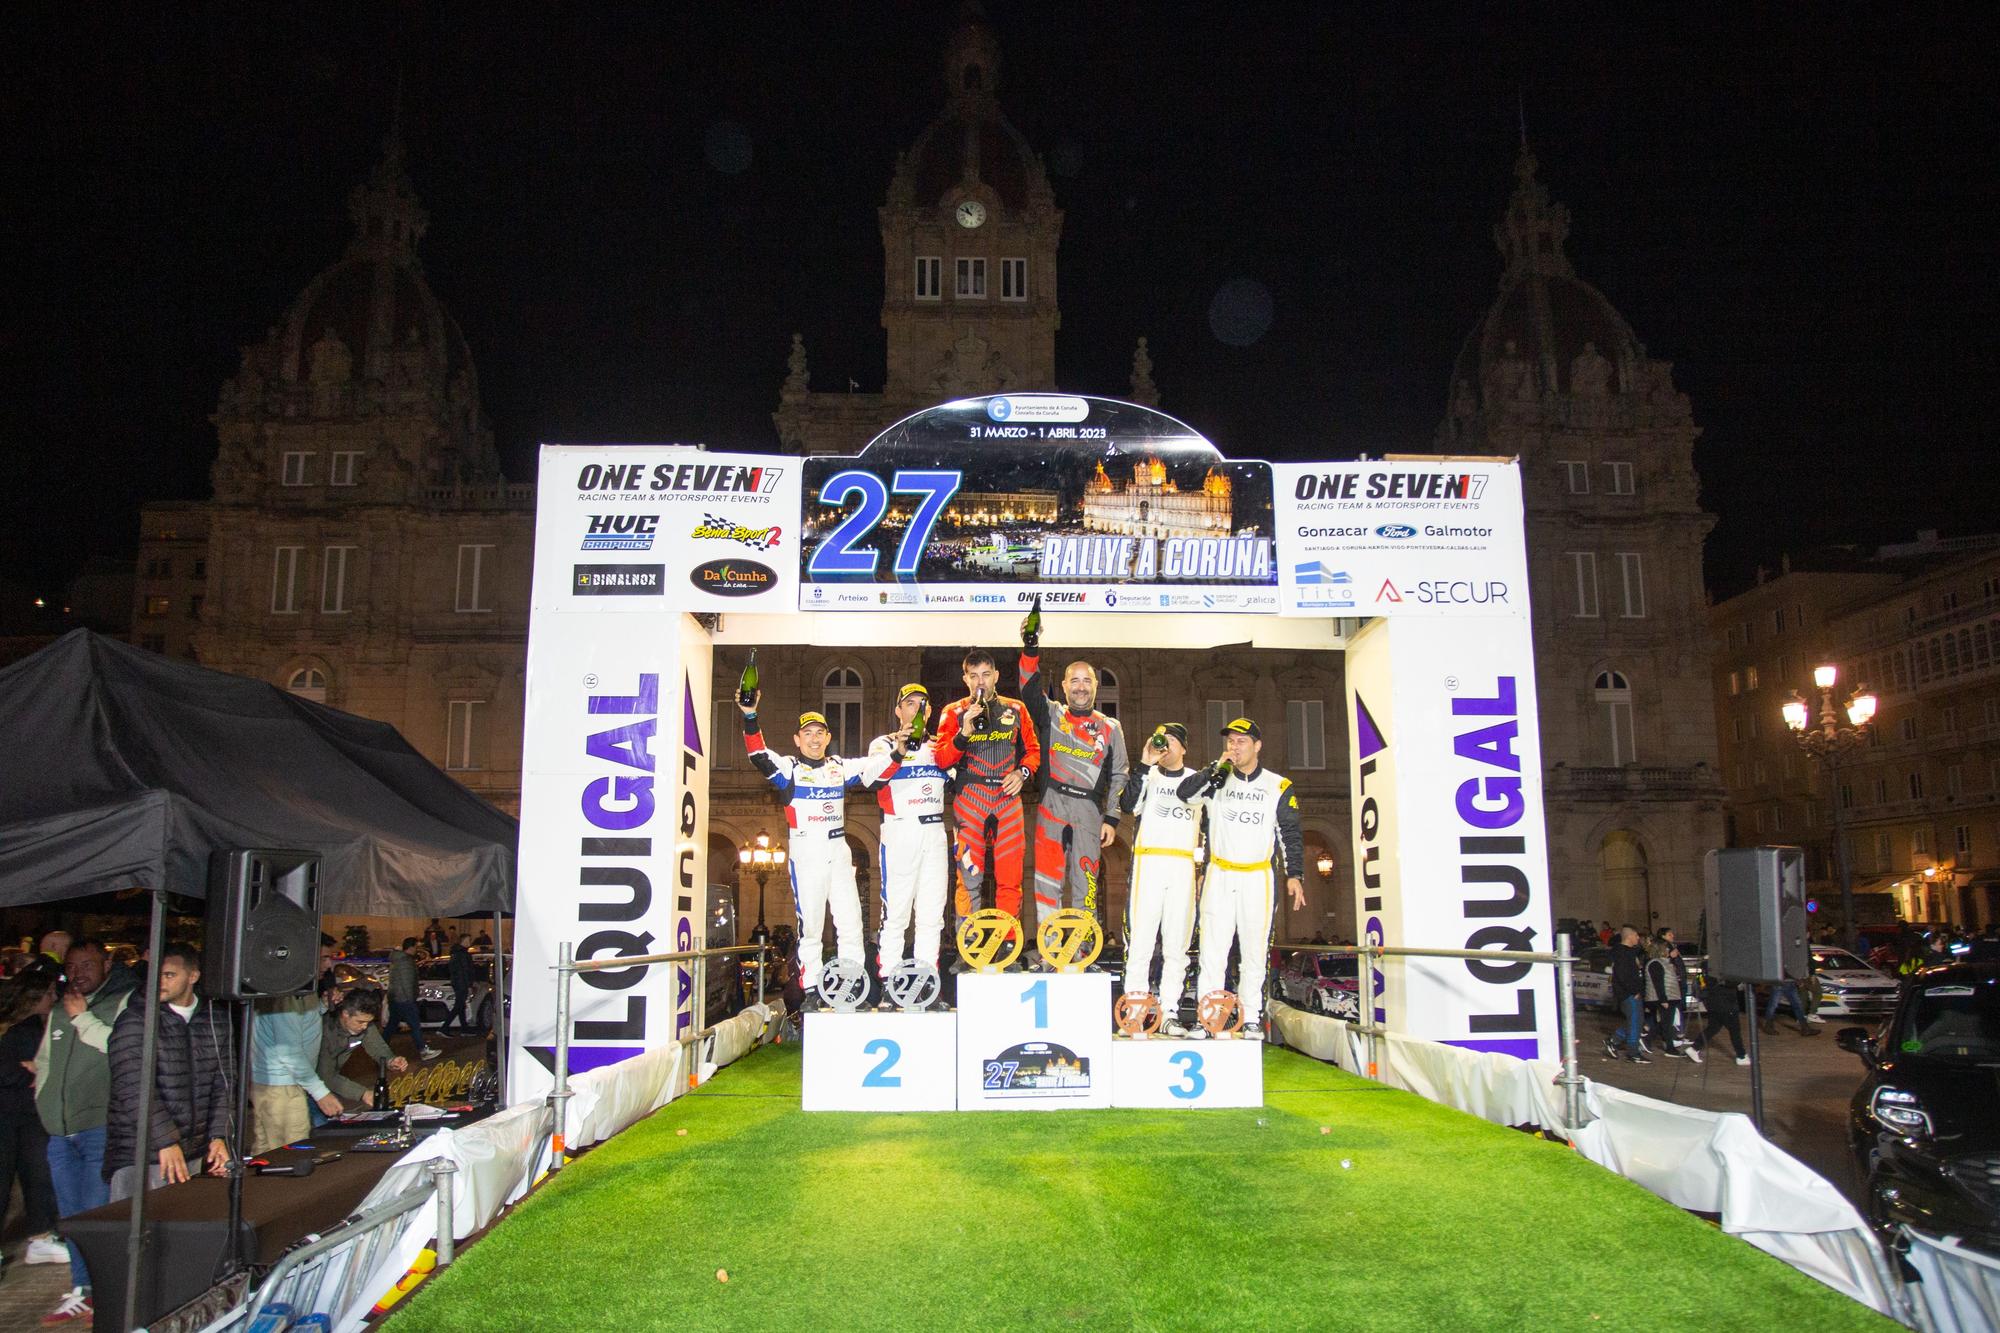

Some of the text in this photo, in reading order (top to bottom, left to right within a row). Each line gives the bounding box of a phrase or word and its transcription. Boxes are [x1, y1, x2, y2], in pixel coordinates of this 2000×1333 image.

[970, 427, 980, 438] 31
[984, 427, 1028, 438] MARZO
[1039, 428, 1044, 438] 1
[1048, 428, 1078, 438] ABRIL
[1080, 428, 1106, 438] 2023
[577, 464, 645, 491] ONE
[1294, 474, 1359, 500] ONE
[658, 494, 728, 502] MOTORSPORT
[730, 495, 770, 504] EVENTS
[1297, 502, 1334, 510] RACING
[1338, 502, 1364, 510] TEAM
[1375, 502, 1441, 510] MOTORSPORT
[1443, 502, 1480, 510] EVENTS
[585, 515, 660, 534] HVC
[808, 471, 962, 575] 27
[692, 525, 782, 546] Senra Sport 2
[1298, 525, 1492, 538] Gonzacar Ford Galmotor
[584, 541, 650, 549] GRAPHICS
[1042, 532, 1270, 577] RALLYE A CORUÑA
[593, 574, 656, 586] DIMALNOX
[704, 570, 768, 581] Da Cunha
[838, 594, 869, 602] Arteixo
[1239, 596, 1276, 607] galicia
[1297, 587, 1352, 600] Tito
[989, 731, 1012, 741] Sport
[1072, 747, 1095, 760] Sport
[1156, 787, 1177, 796] IAM
[1226, 789, 1264, 801] IAMANI
[1172, 806, 1195, 821] GSI
[1239, 811, 1264, 825] GSI
[573, 673, 660, 1040] LQUIGAL
[1450, 676, 1538, 1034] LQUIGAL
[1080, 856, 1100, 874] 2
[1085, 871, 1096, 909] Sport
[966, 920, 1014, 964] 27
[1045, 920, 1093, 964] 27
[1020, 981, 1048, 1028] 1
[861, 1039, 901, 1087] 2
[985, 1061, 1019, 1088] 27
[1168, 1051, 1206, 1099] 3
